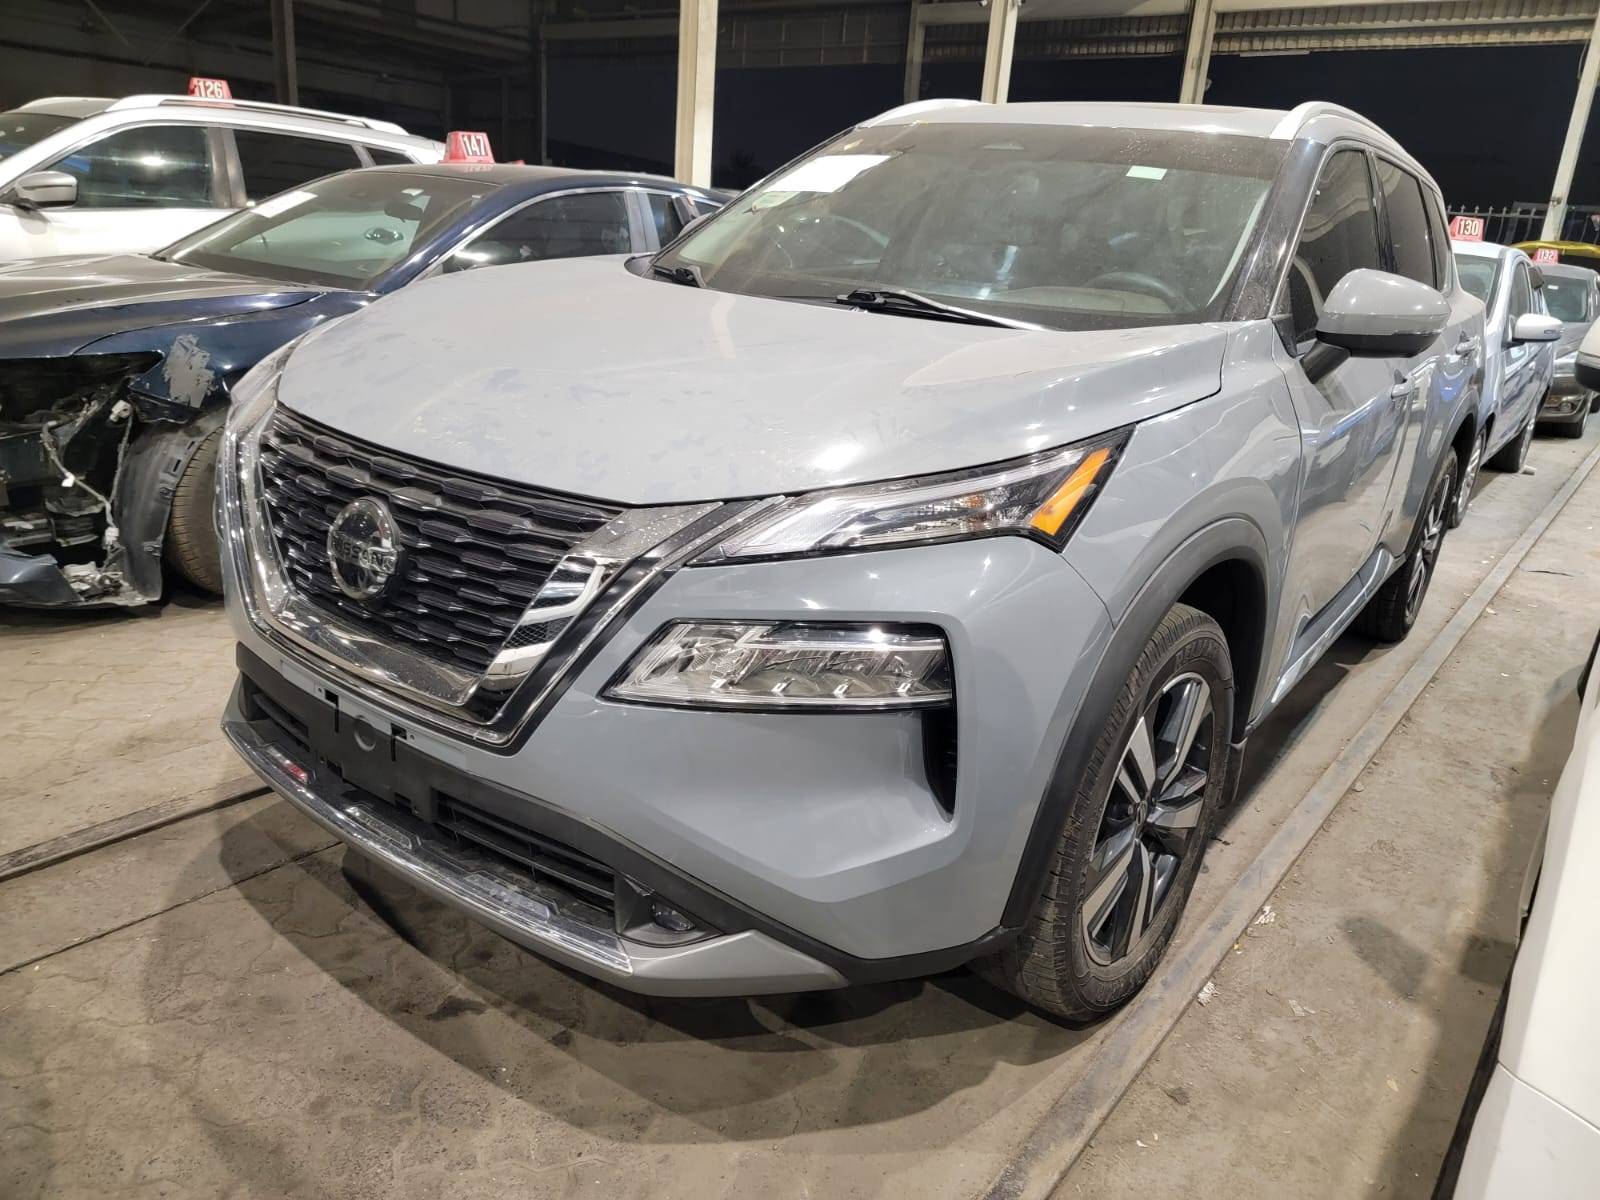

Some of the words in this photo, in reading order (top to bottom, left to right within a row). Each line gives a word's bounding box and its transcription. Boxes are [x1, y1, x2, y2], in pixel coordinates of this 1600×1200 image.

[198, 80, 223, 98] 126
[462, 134, 487, 156] 147
[1460, 219, 1479, 236] 130
